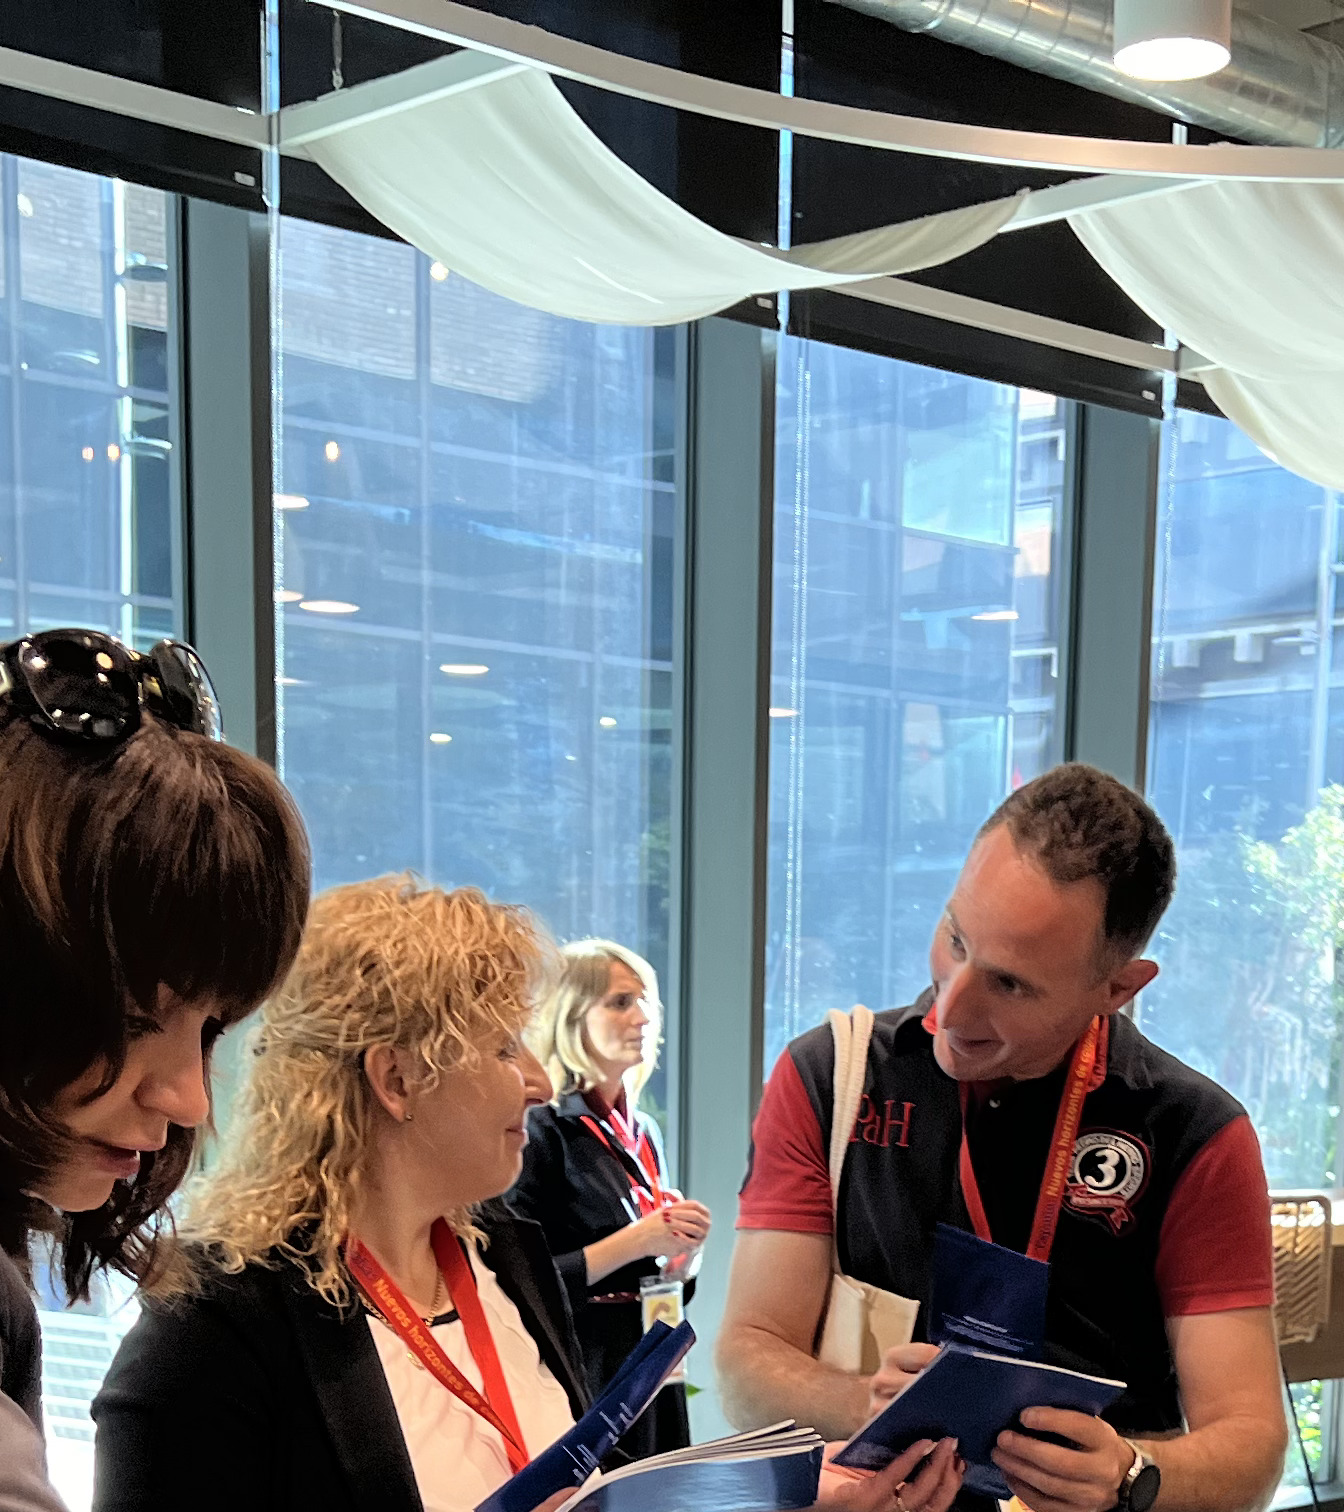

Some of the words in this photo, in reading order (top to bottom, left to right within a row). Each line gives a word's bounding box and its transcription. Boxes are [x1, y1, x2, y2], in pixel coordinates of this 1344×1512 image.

[1046, 1150, 1067, 1197] Nuevos
[1058, 1081, 1083, 1147] horizontes
[1083, 1149, 1120, 1188] 3
[373, 1278, 411, 1328] Nuevos
[409, 1325, 464, 1391] horizontes
